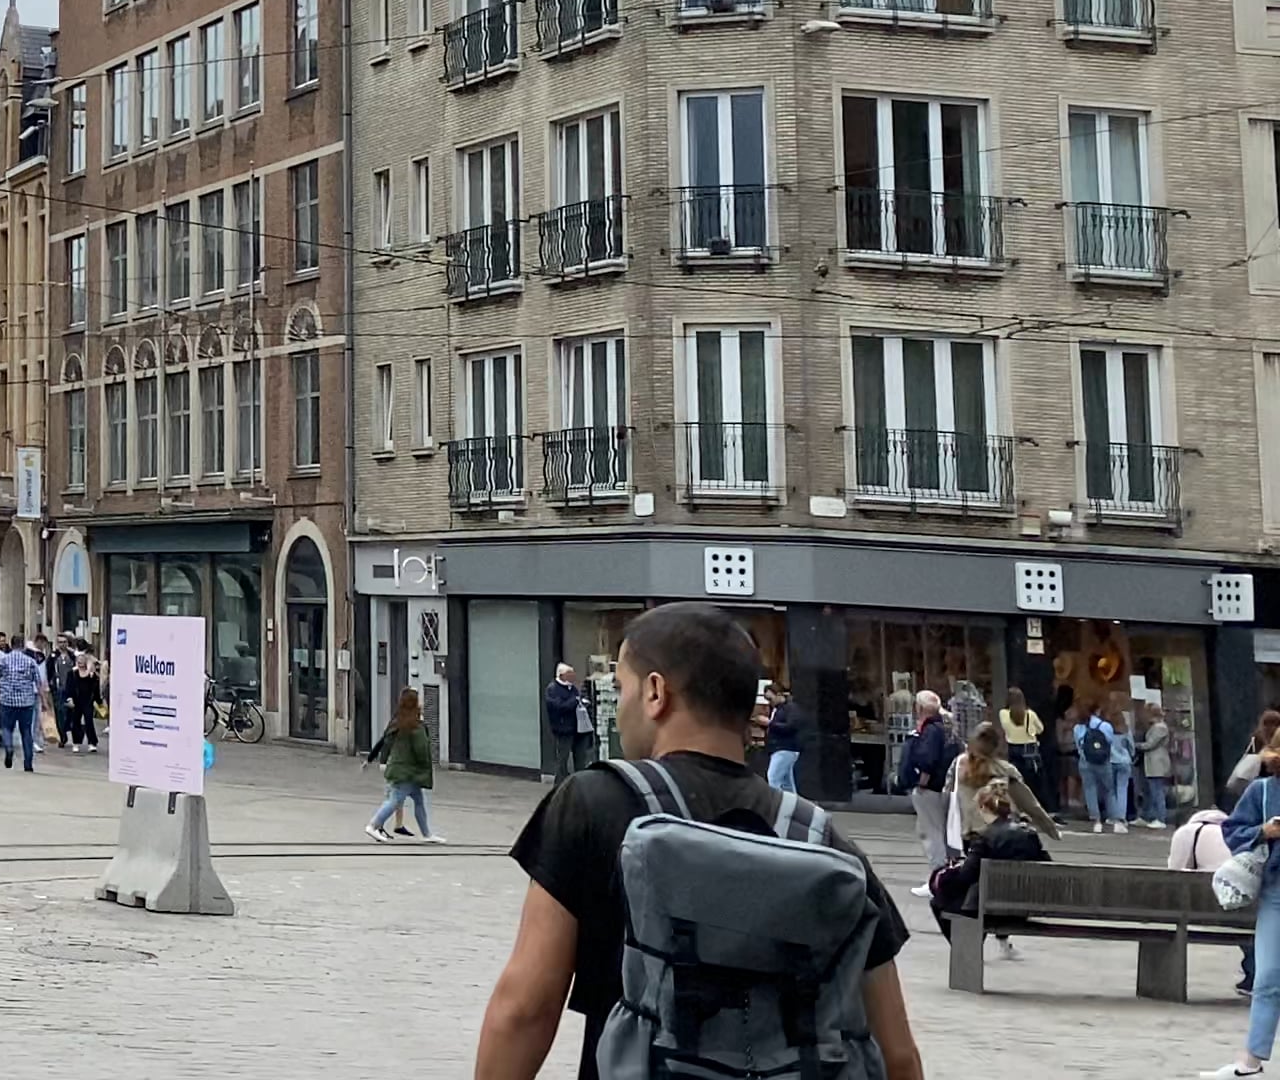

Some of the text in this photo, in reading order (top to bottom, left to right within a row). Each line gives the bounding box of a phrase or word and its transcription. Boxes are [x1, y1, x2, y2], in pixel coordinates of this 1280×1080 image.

[713, 579, 746, 588] SIX
[1026, 595, 1056, 604] SIX
[135, 654, 175, 676] Welkom
